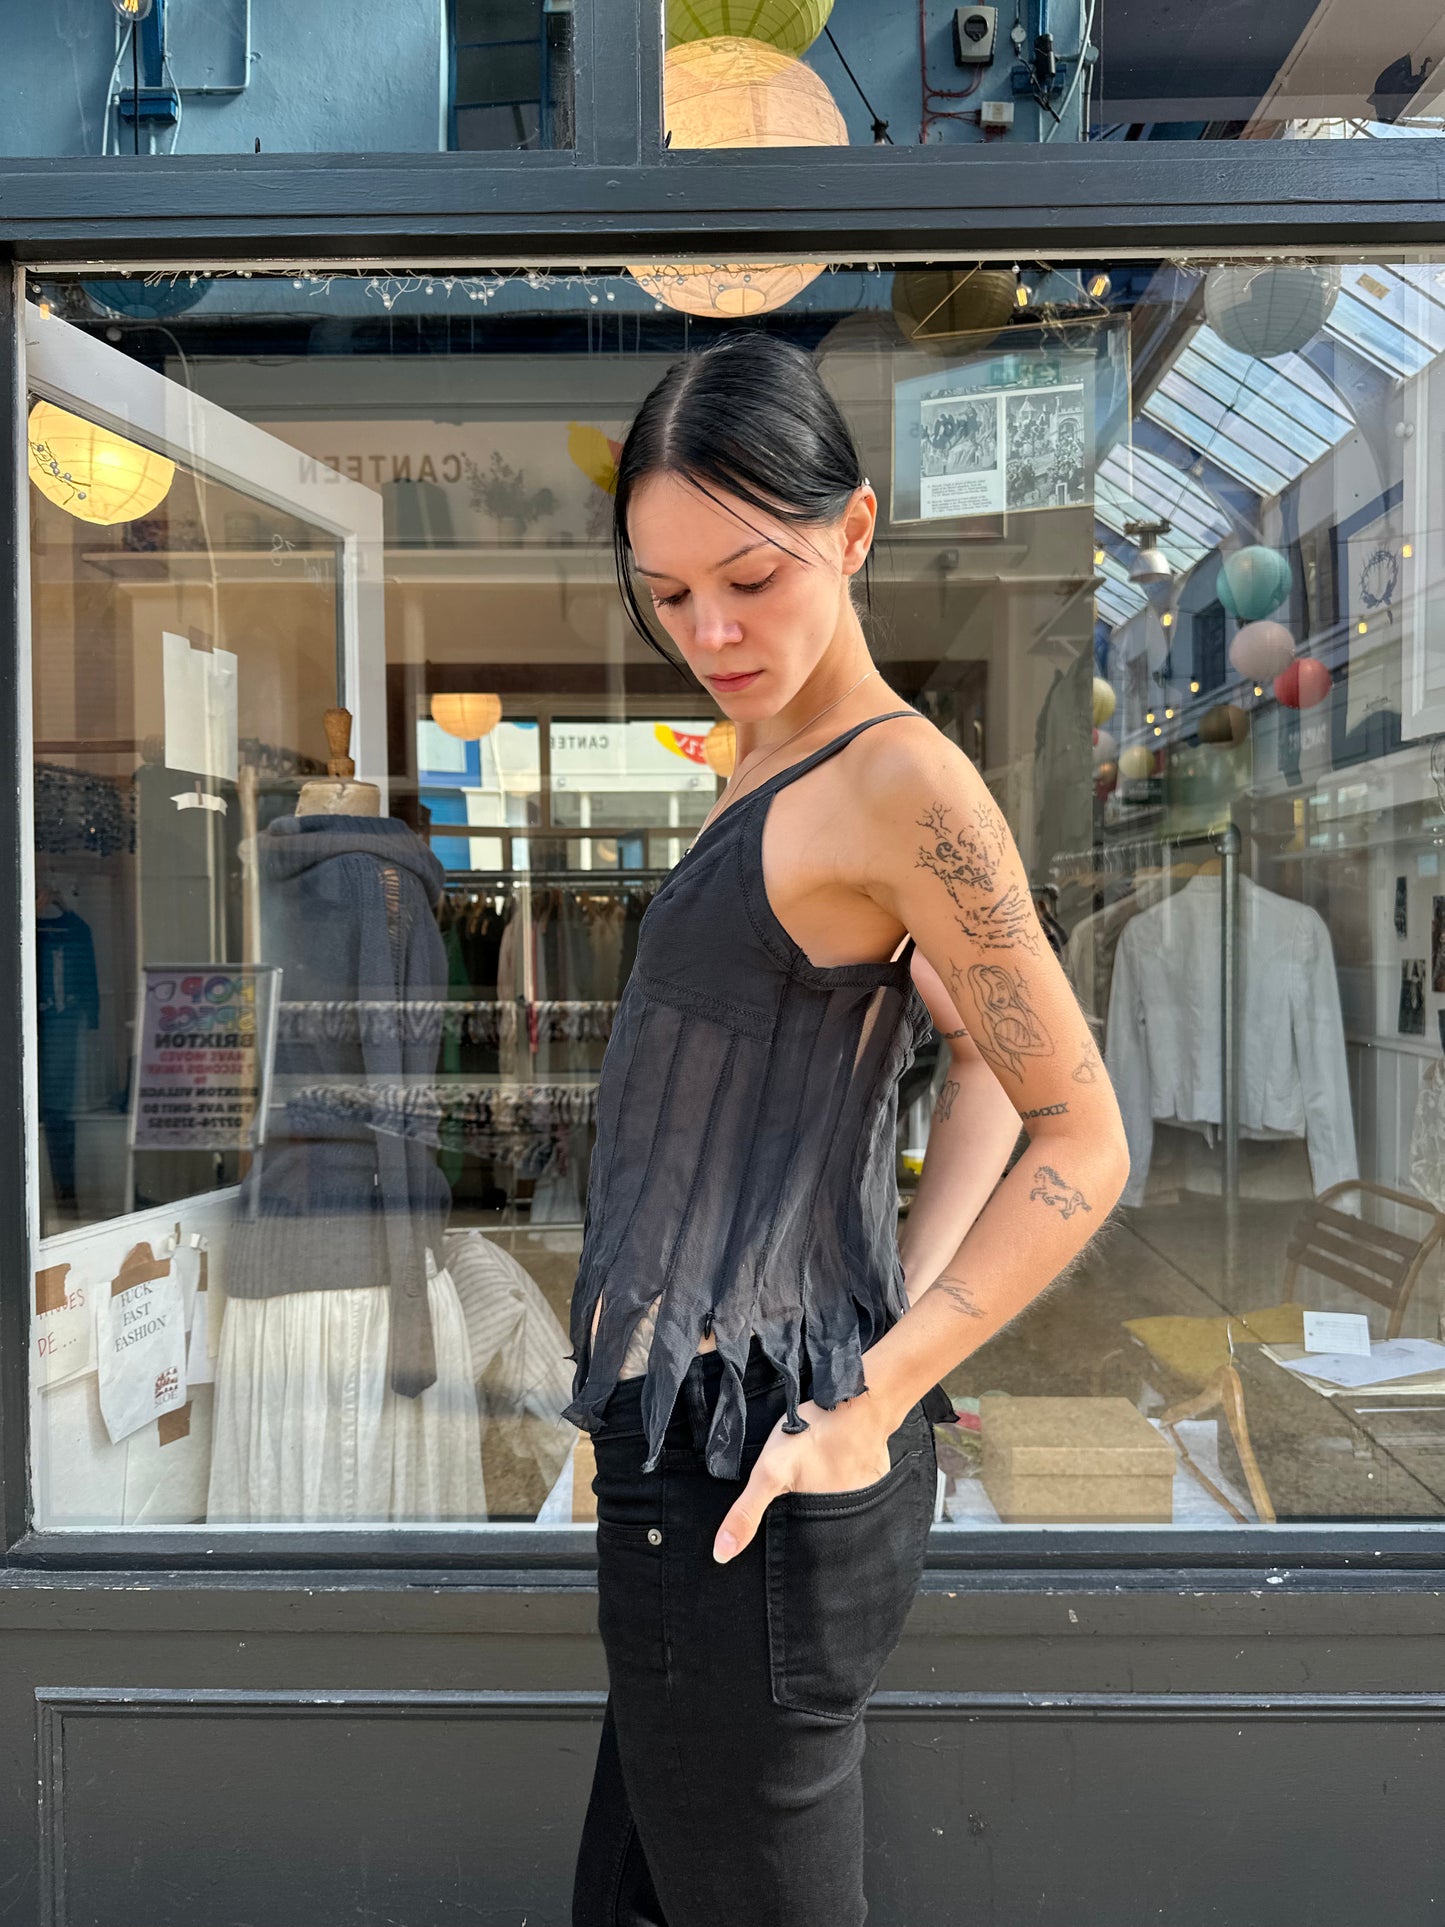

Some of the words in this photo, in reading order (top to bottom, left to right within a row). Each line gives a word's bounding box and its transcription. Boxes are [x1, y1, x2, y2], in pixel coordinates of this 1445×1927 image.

[120, 1282, 153, 1308] FUCK
[123, 1301, 151, 1327] FAST
[114, 1315, 166, 1352] FASHION
